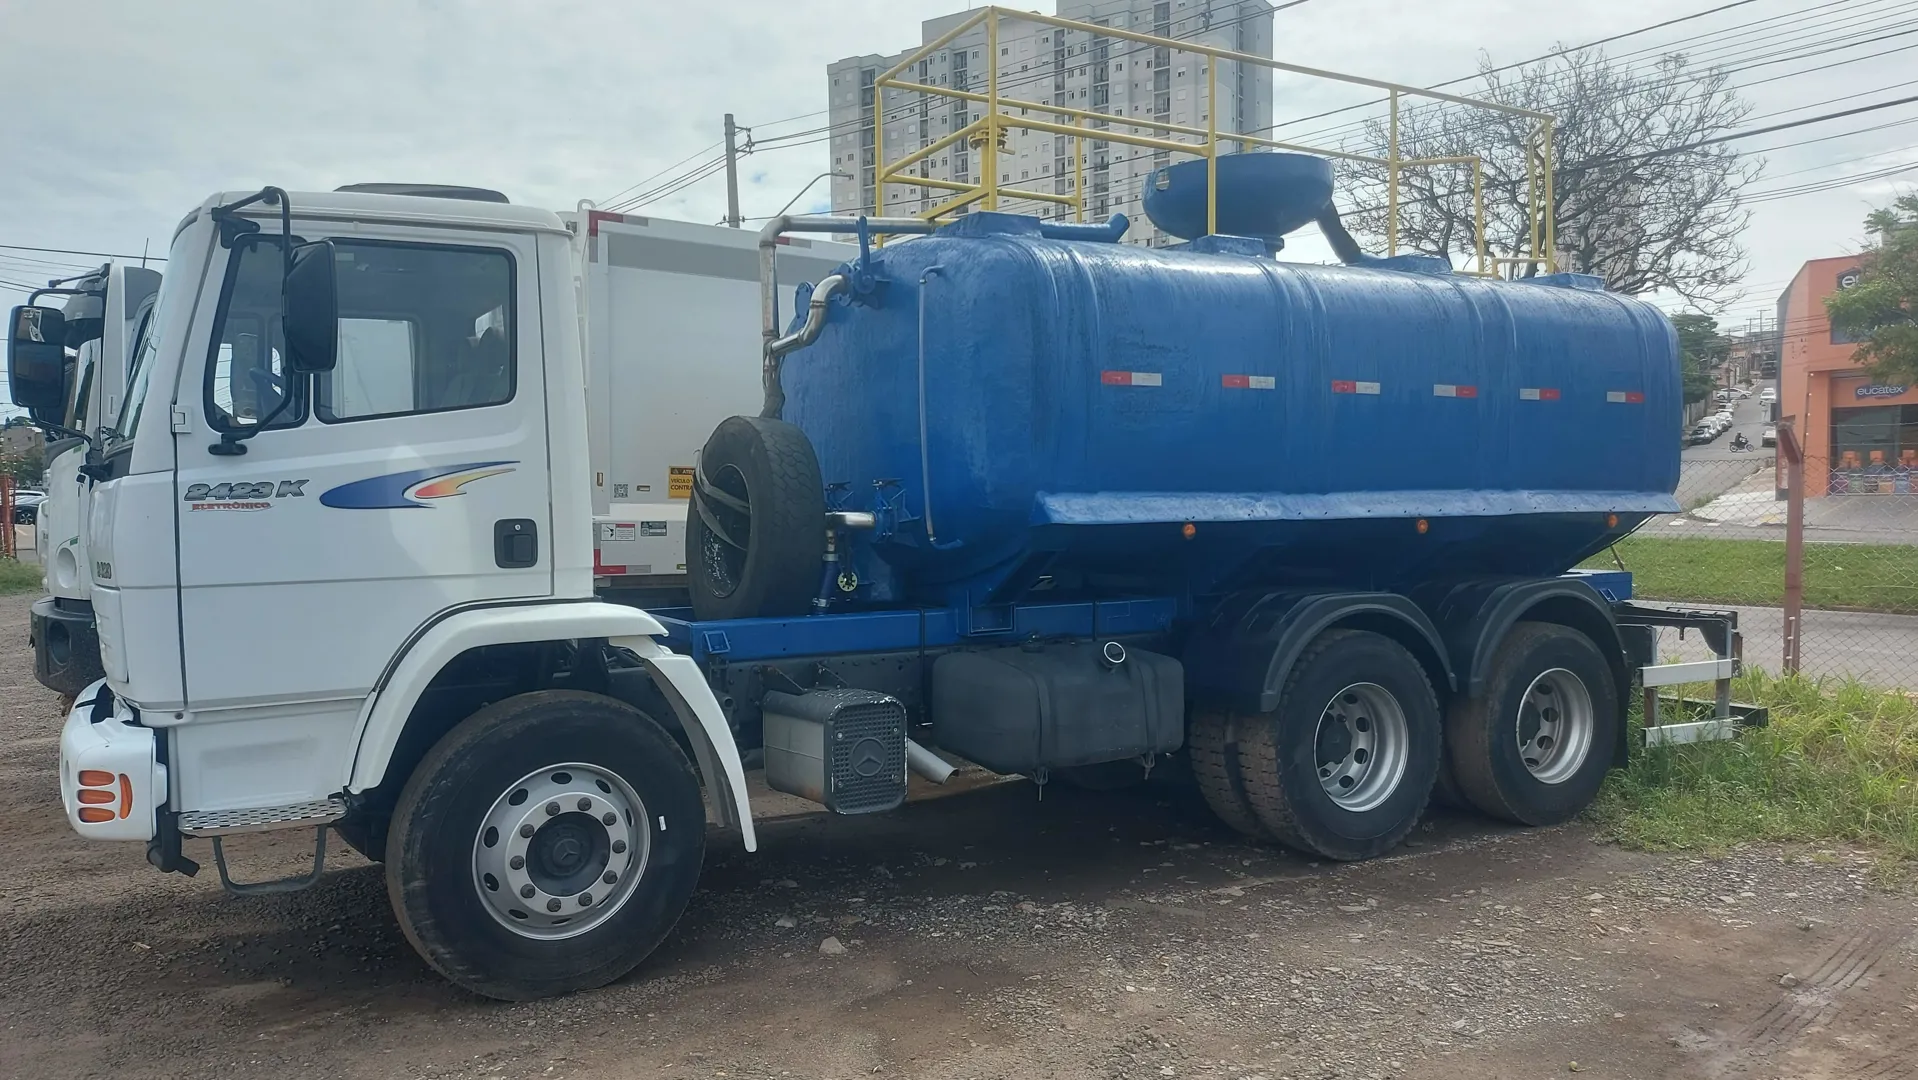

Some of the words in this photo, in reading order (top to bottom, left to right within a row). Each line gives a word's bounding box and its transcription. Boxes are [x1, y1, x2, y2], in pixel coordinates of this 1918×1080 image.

[1857, 386, 1903, 395] eucatex
[184, 482, 275, 501] 2423
[275, 479, 310, 498] K
[192, 501, 271, 511] ELETRÔNICO
